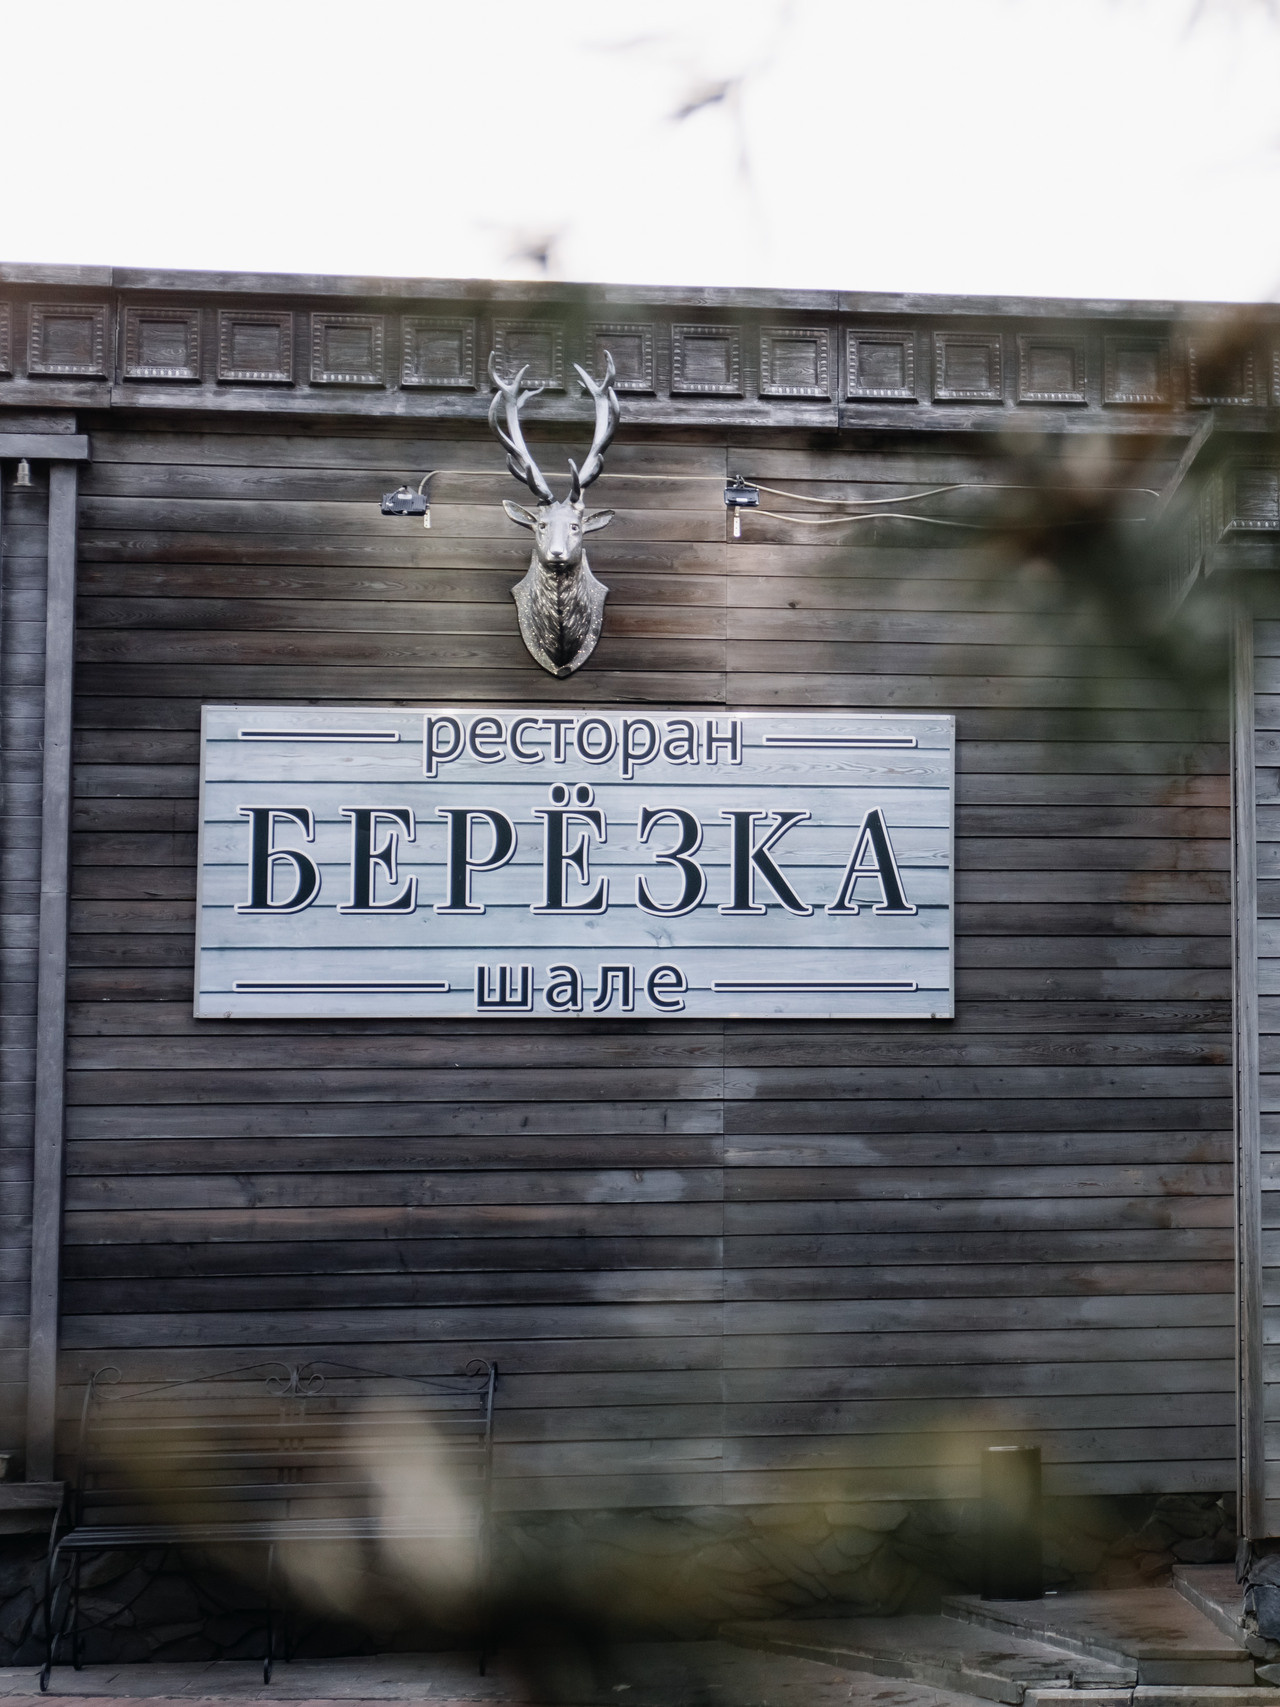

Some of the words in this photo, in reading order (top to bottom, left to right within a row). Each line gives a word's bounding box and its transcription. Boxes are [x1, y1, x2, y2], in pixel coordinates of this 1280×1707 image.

[424, 715, 743, 779] ресторан
[235, 783, 918, 916] БЕРЁЗКА
[474, 963, 687, 1011] шале
